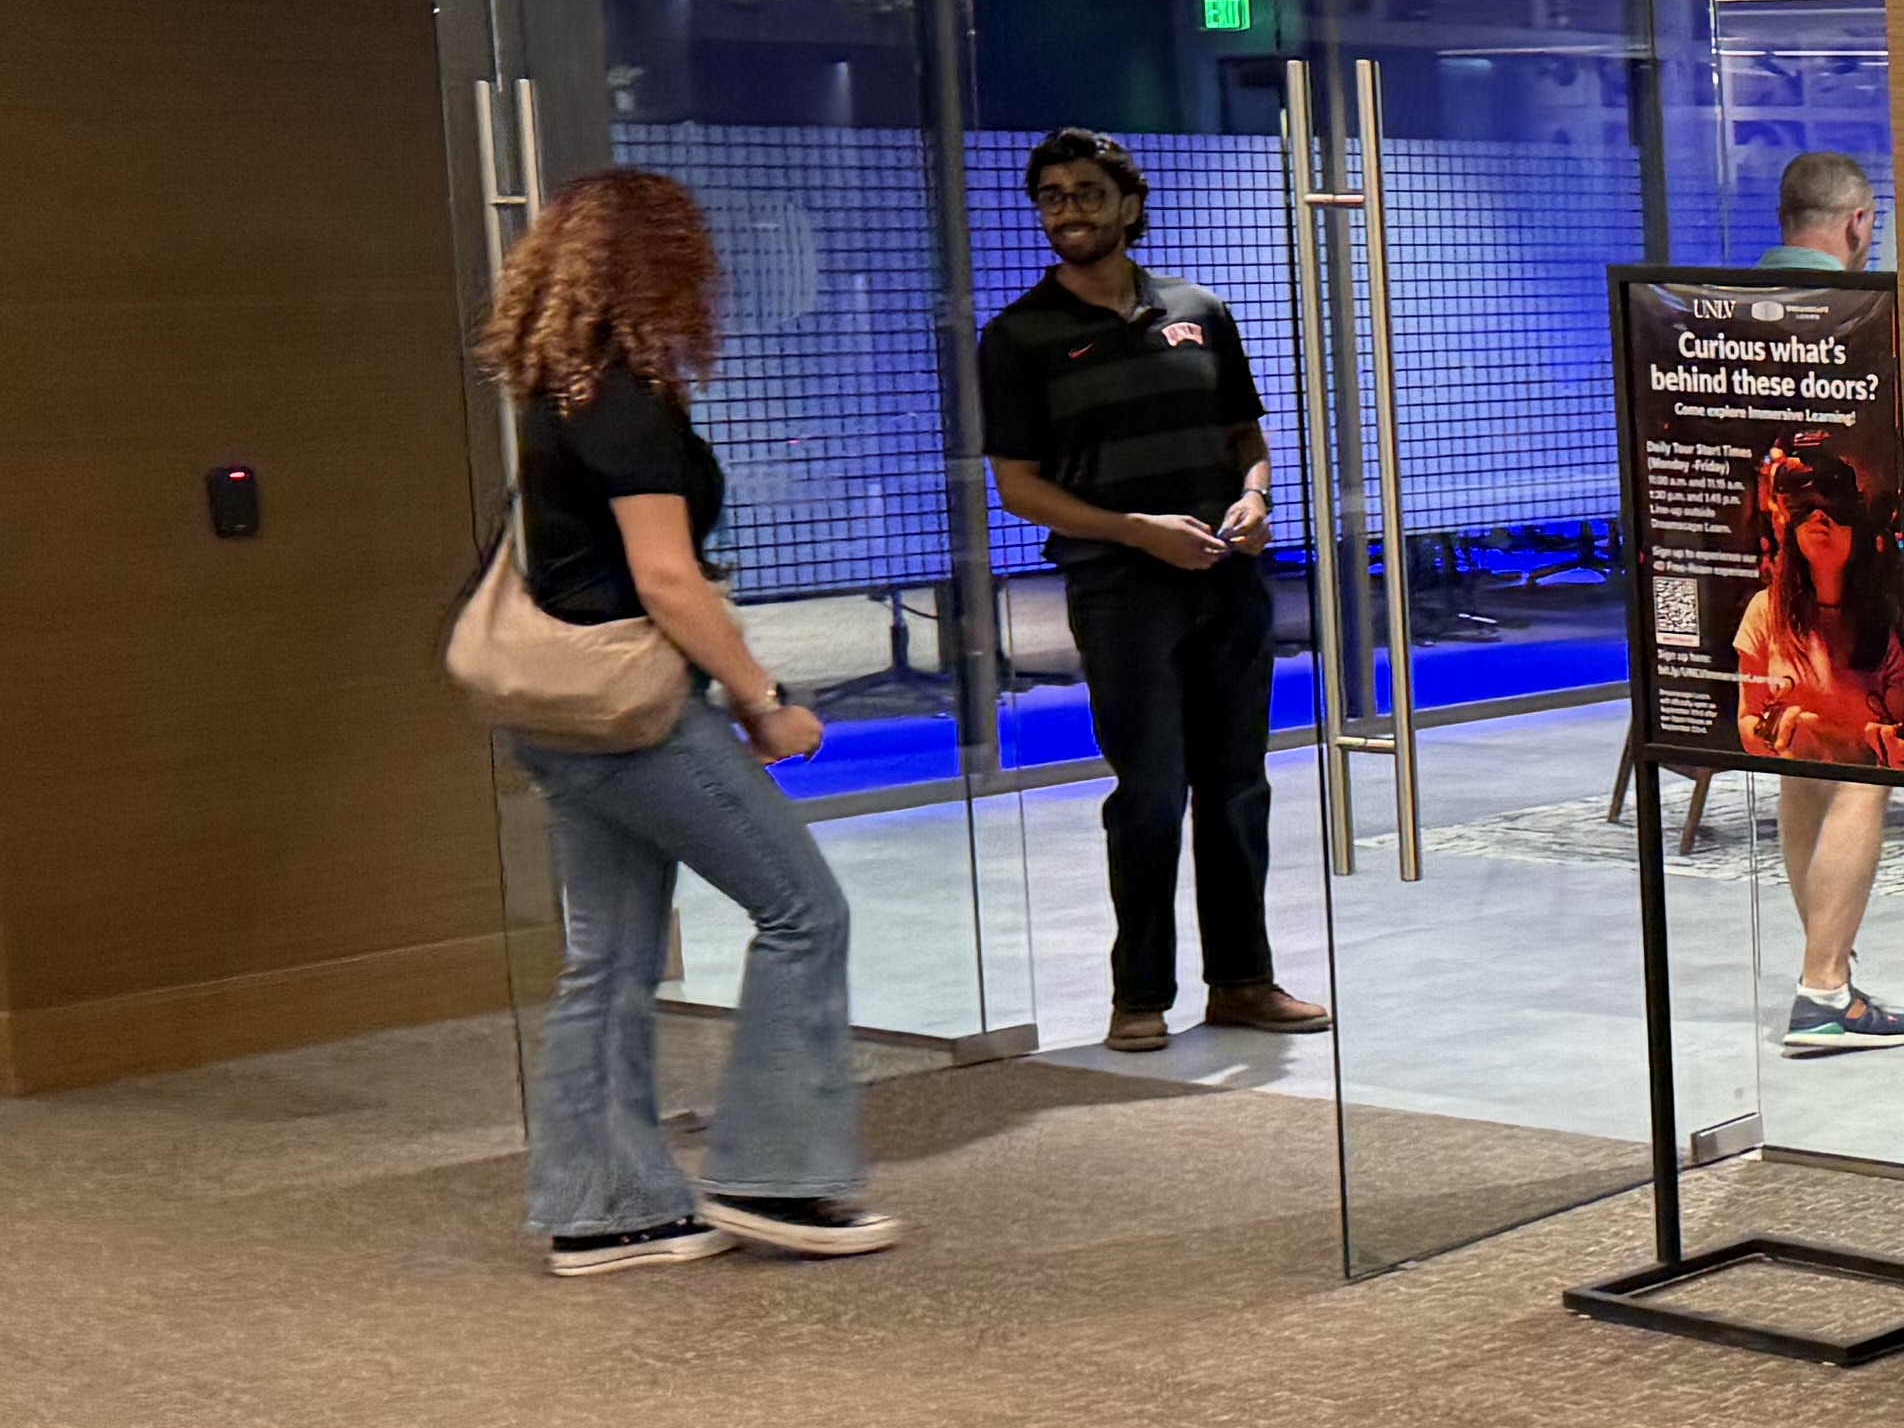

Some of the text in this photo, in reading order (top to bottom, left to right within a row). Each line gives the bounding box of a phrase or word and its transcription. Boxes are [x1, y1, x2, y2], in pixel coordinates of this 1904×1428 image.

[1693, 299, 1737, 319] UNLV
[1678, 331, 1847, 365] Curious what's
[1650, 364, 1879, 401] behind these doors?
[1674, 402, 1705, 416] Come
